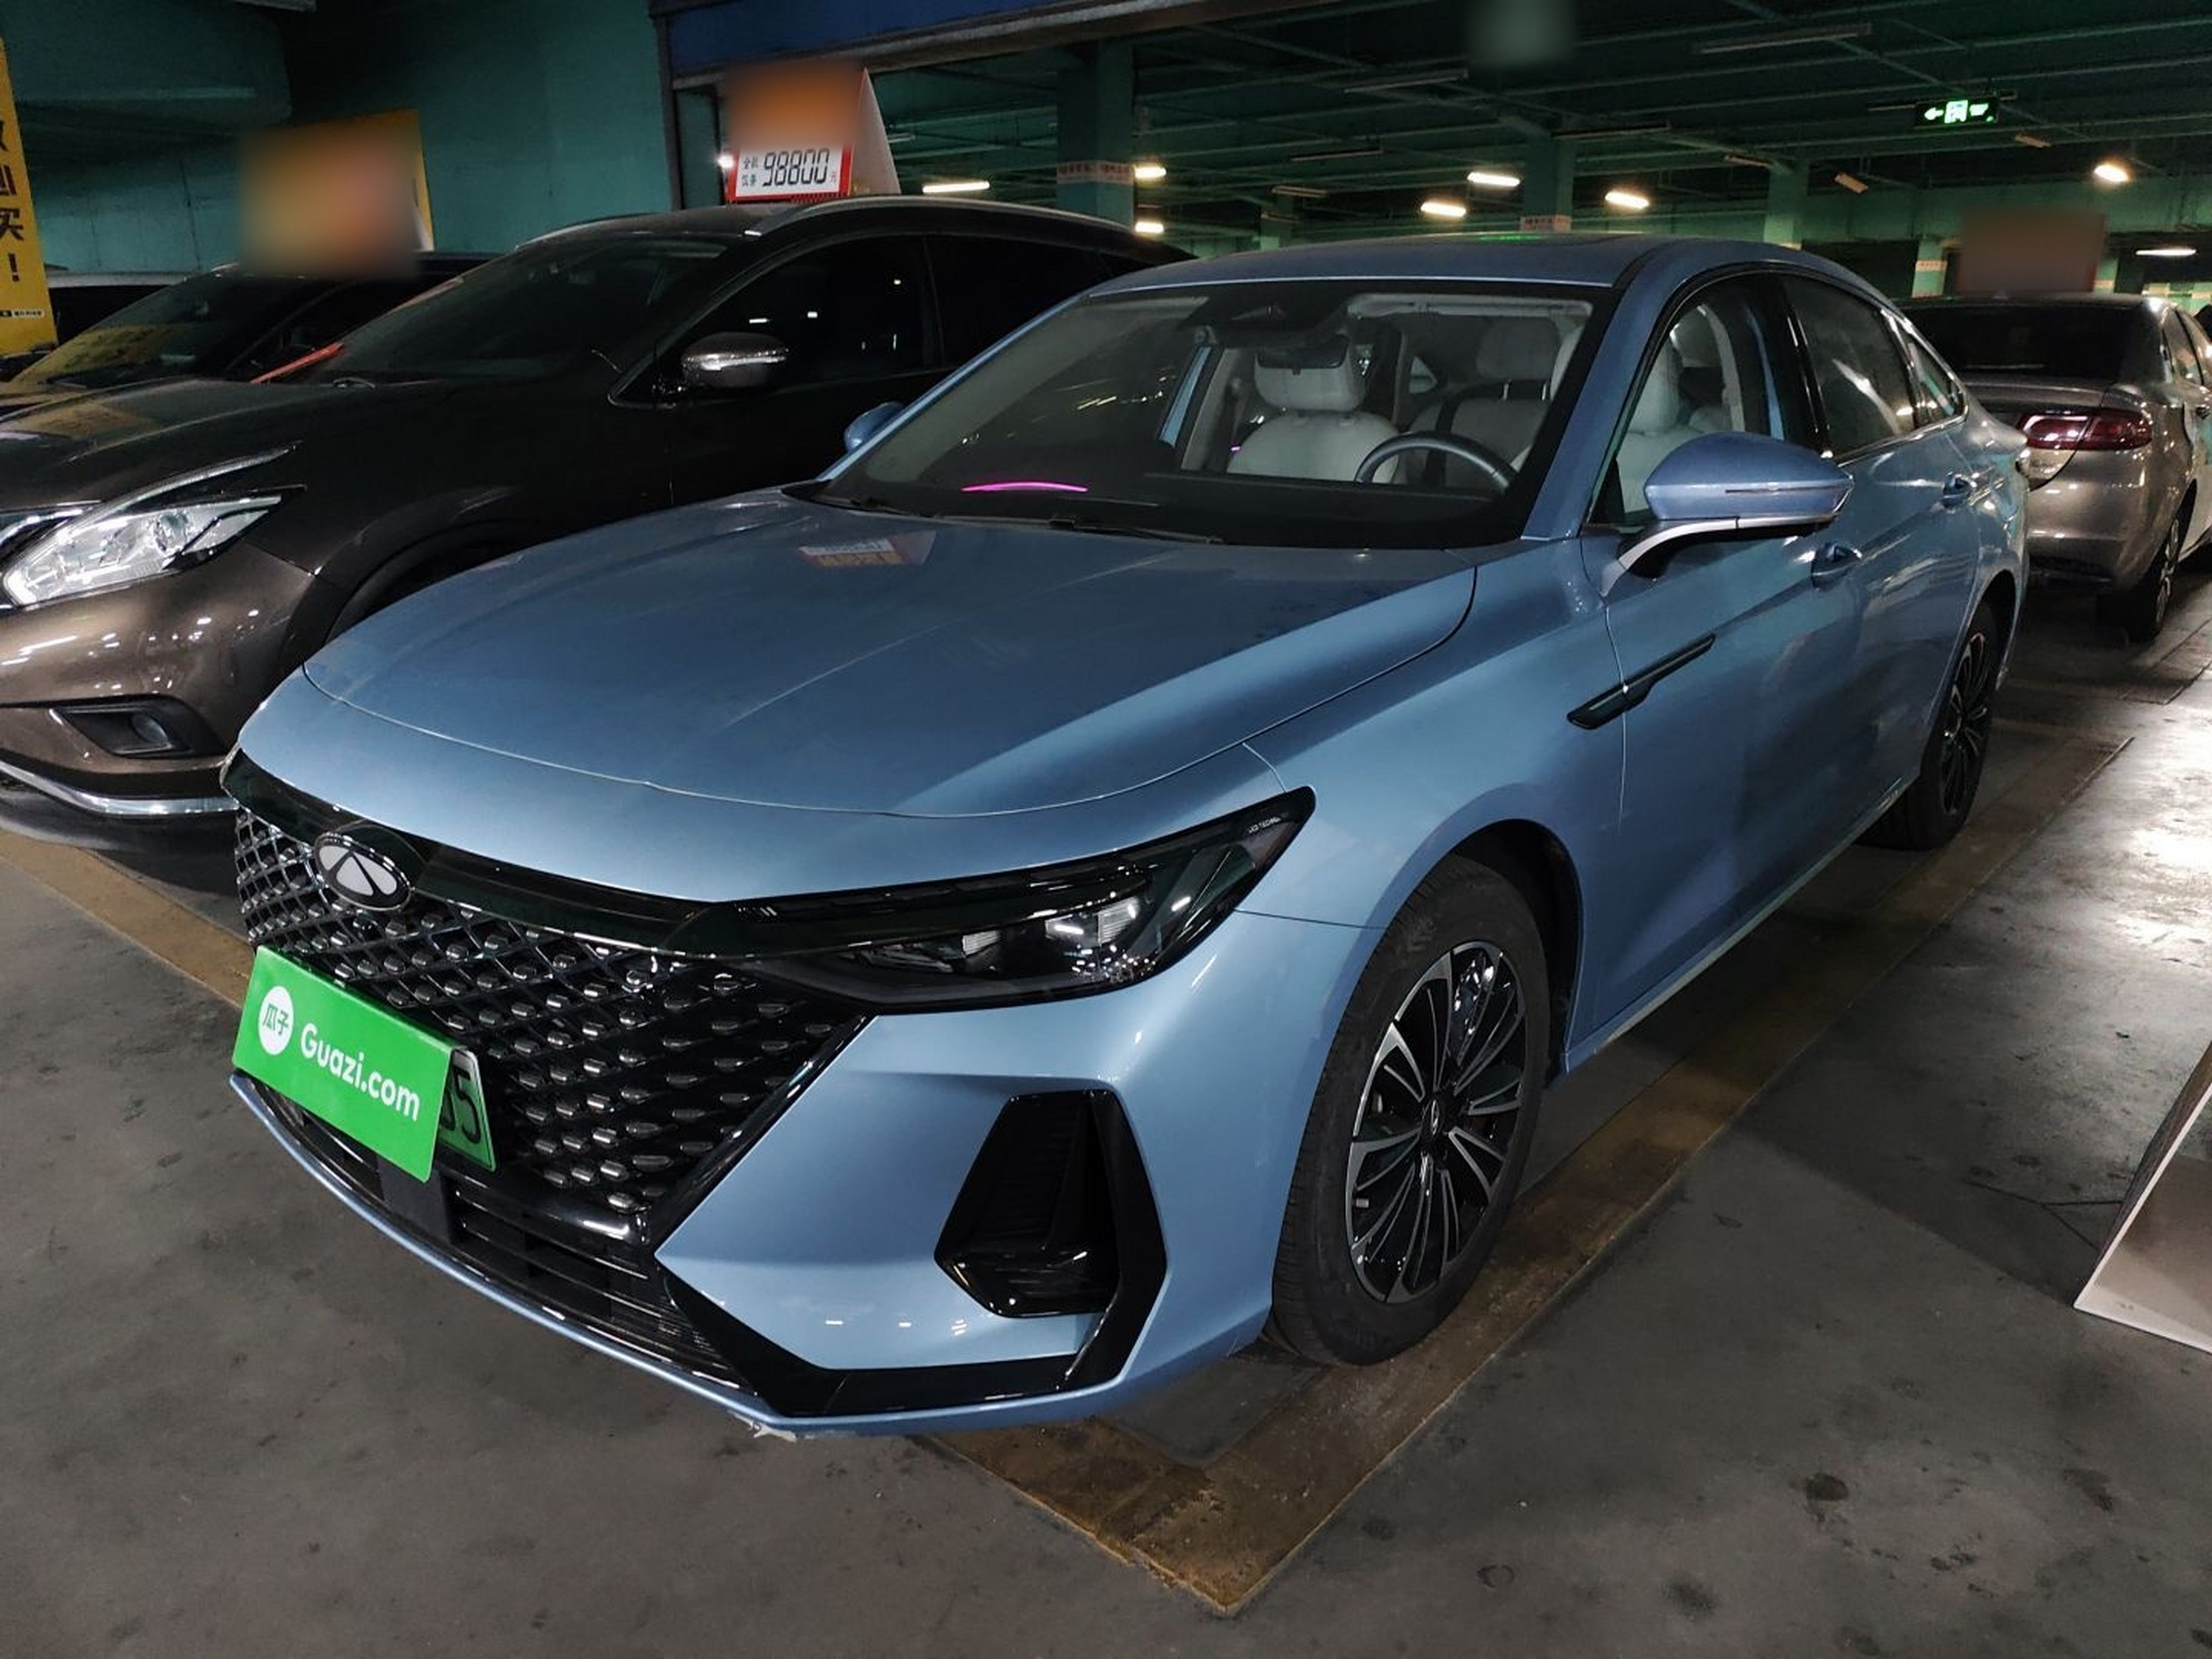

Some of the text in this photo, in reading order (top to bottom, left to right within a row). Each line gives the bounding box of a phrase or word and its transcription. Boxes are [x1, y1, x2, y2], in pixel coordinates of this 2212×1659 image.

[762, 147, 830, 187] 98800
[263, 1003, 289, 1036] 瓜子
[301, 1022, 420, 1121] Guazi.com
